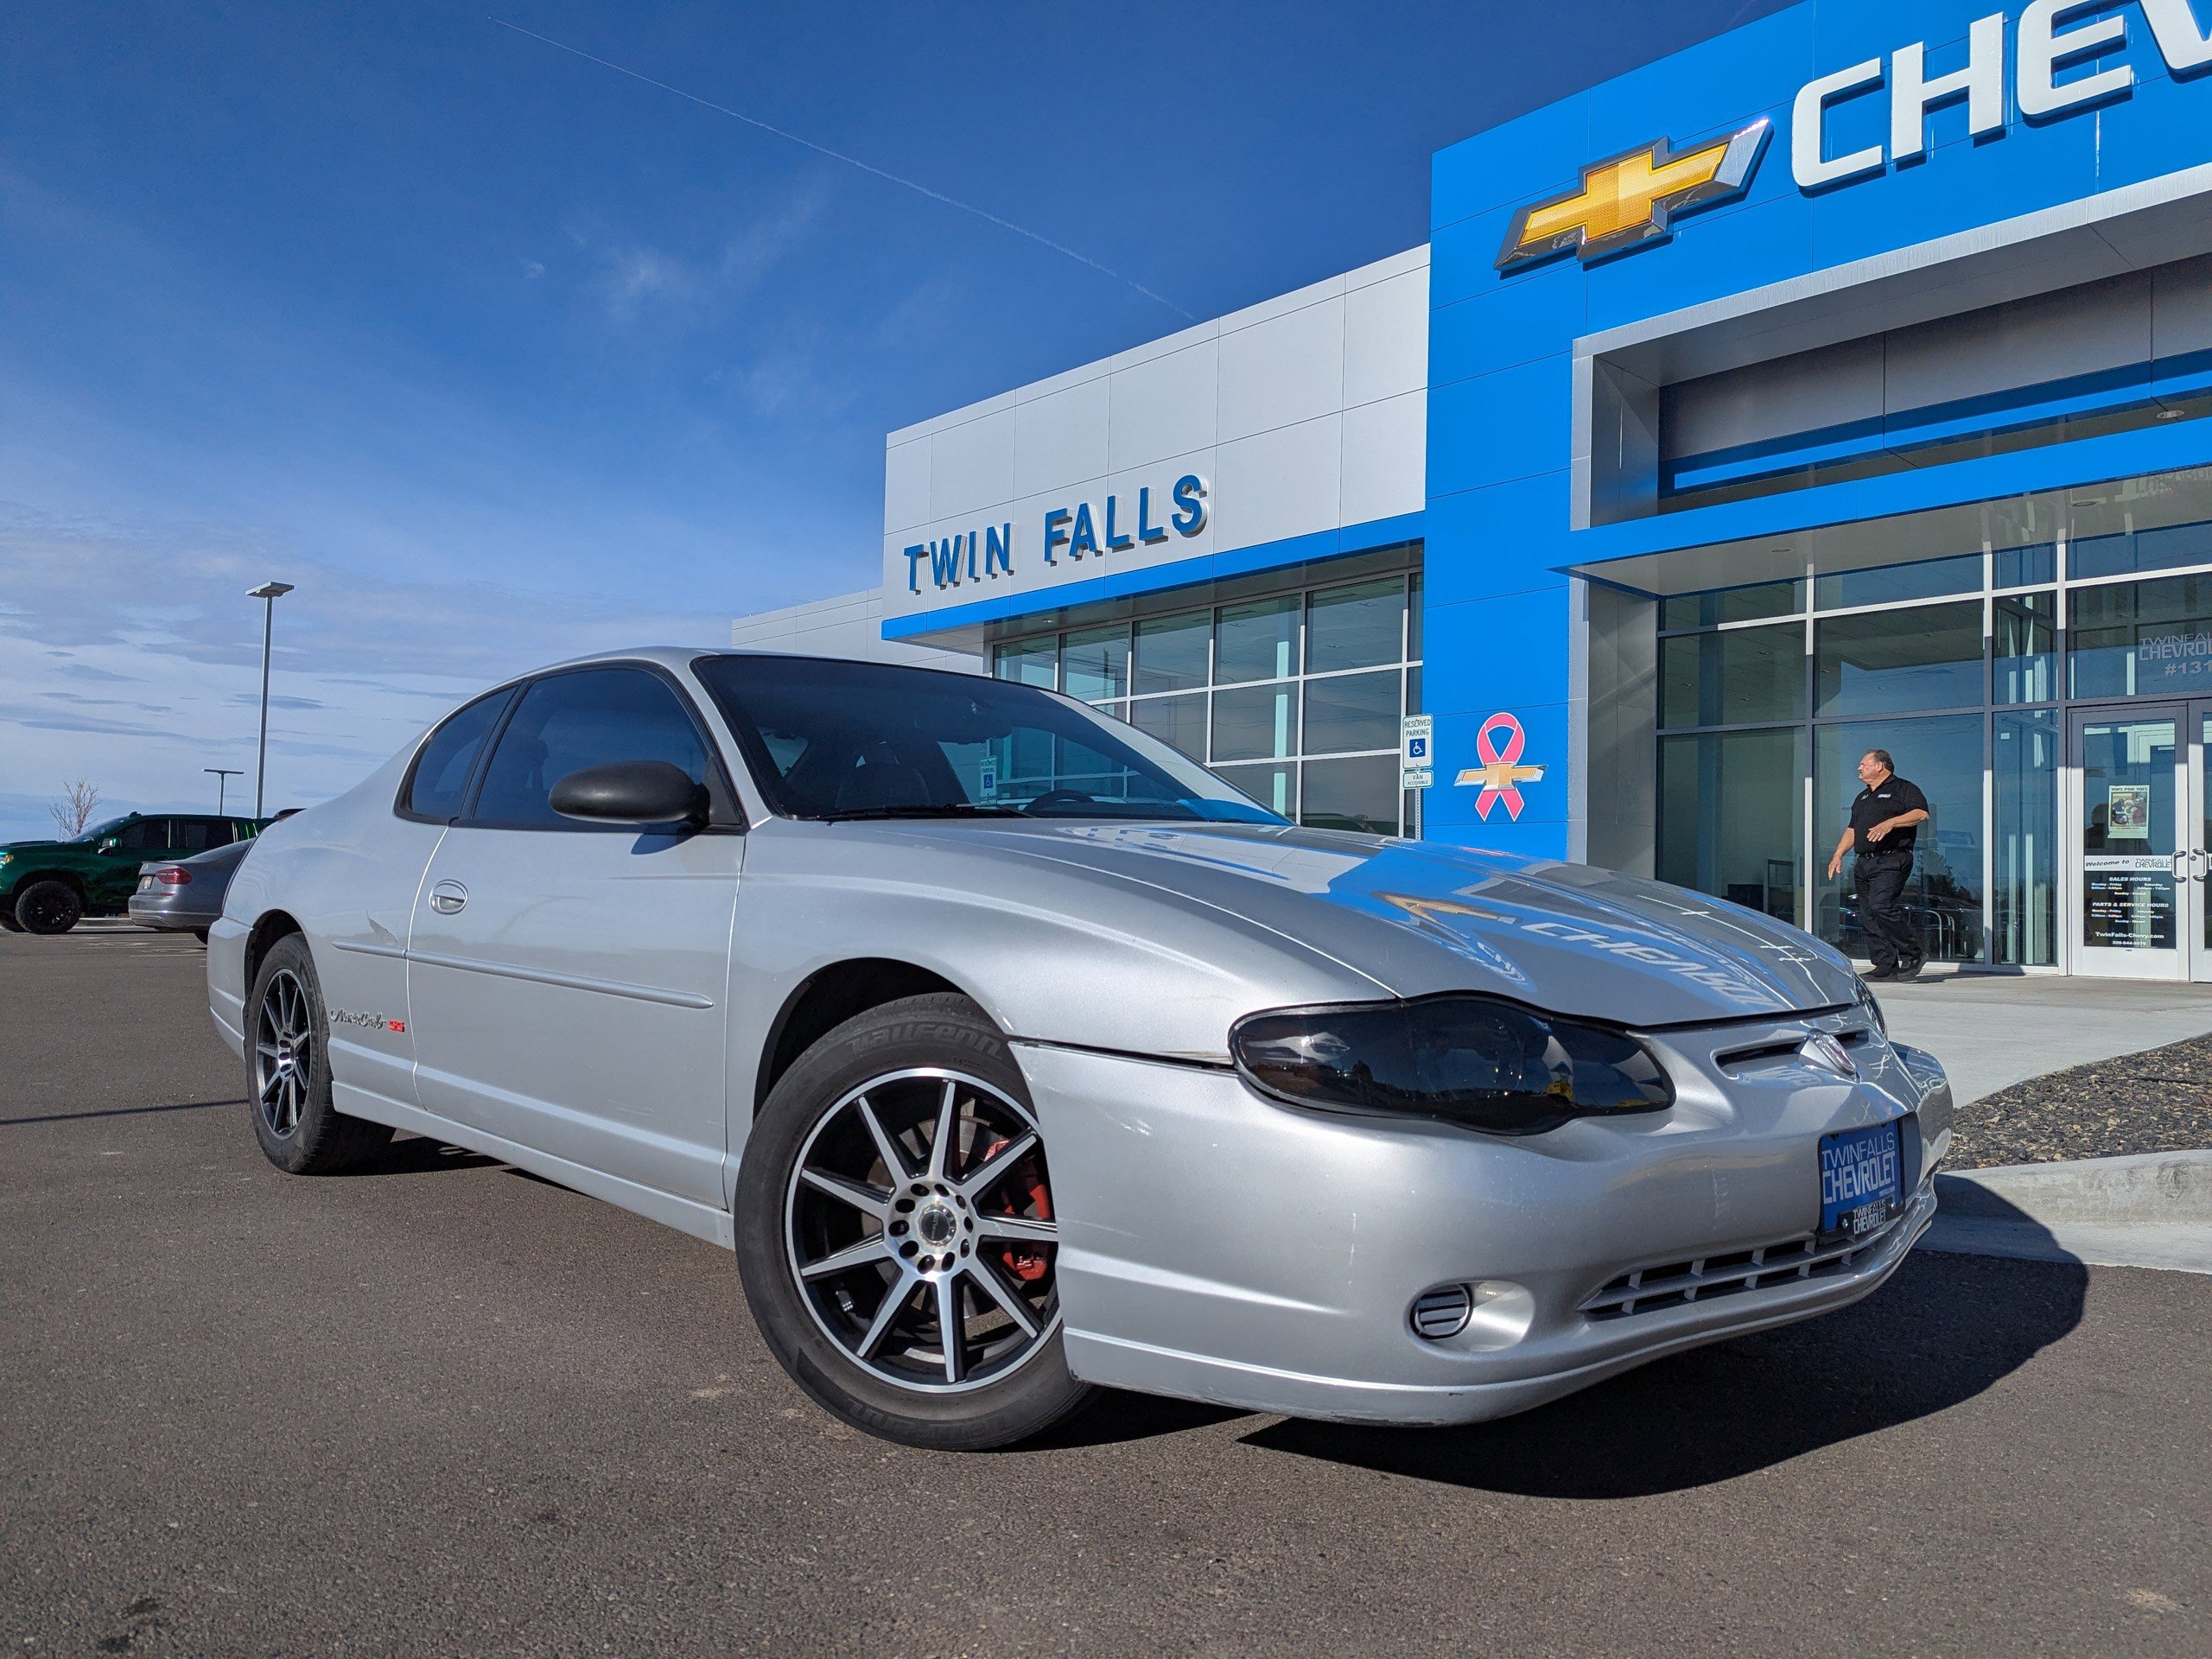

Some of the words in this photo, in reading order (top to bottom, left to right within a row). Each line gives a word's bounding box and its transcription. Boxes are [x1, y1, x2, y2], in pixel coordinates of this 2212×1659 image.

[904, 523, 1013, 594] TWIN
[1044, 474, 1207, 566] FALLS
[1404, 719, 1431, 728] RESERVED
[1406, 728, 1429, 737] PARKING
[1821, 1132, 1895, 1170] TWINFALLS
[1821, 1151, 1896, 1204] CHEVROLET
[1853, 1199, 1886, 1219] TWINFALLS
[1853, 1209, 1886, 1235] CHEVROLET
